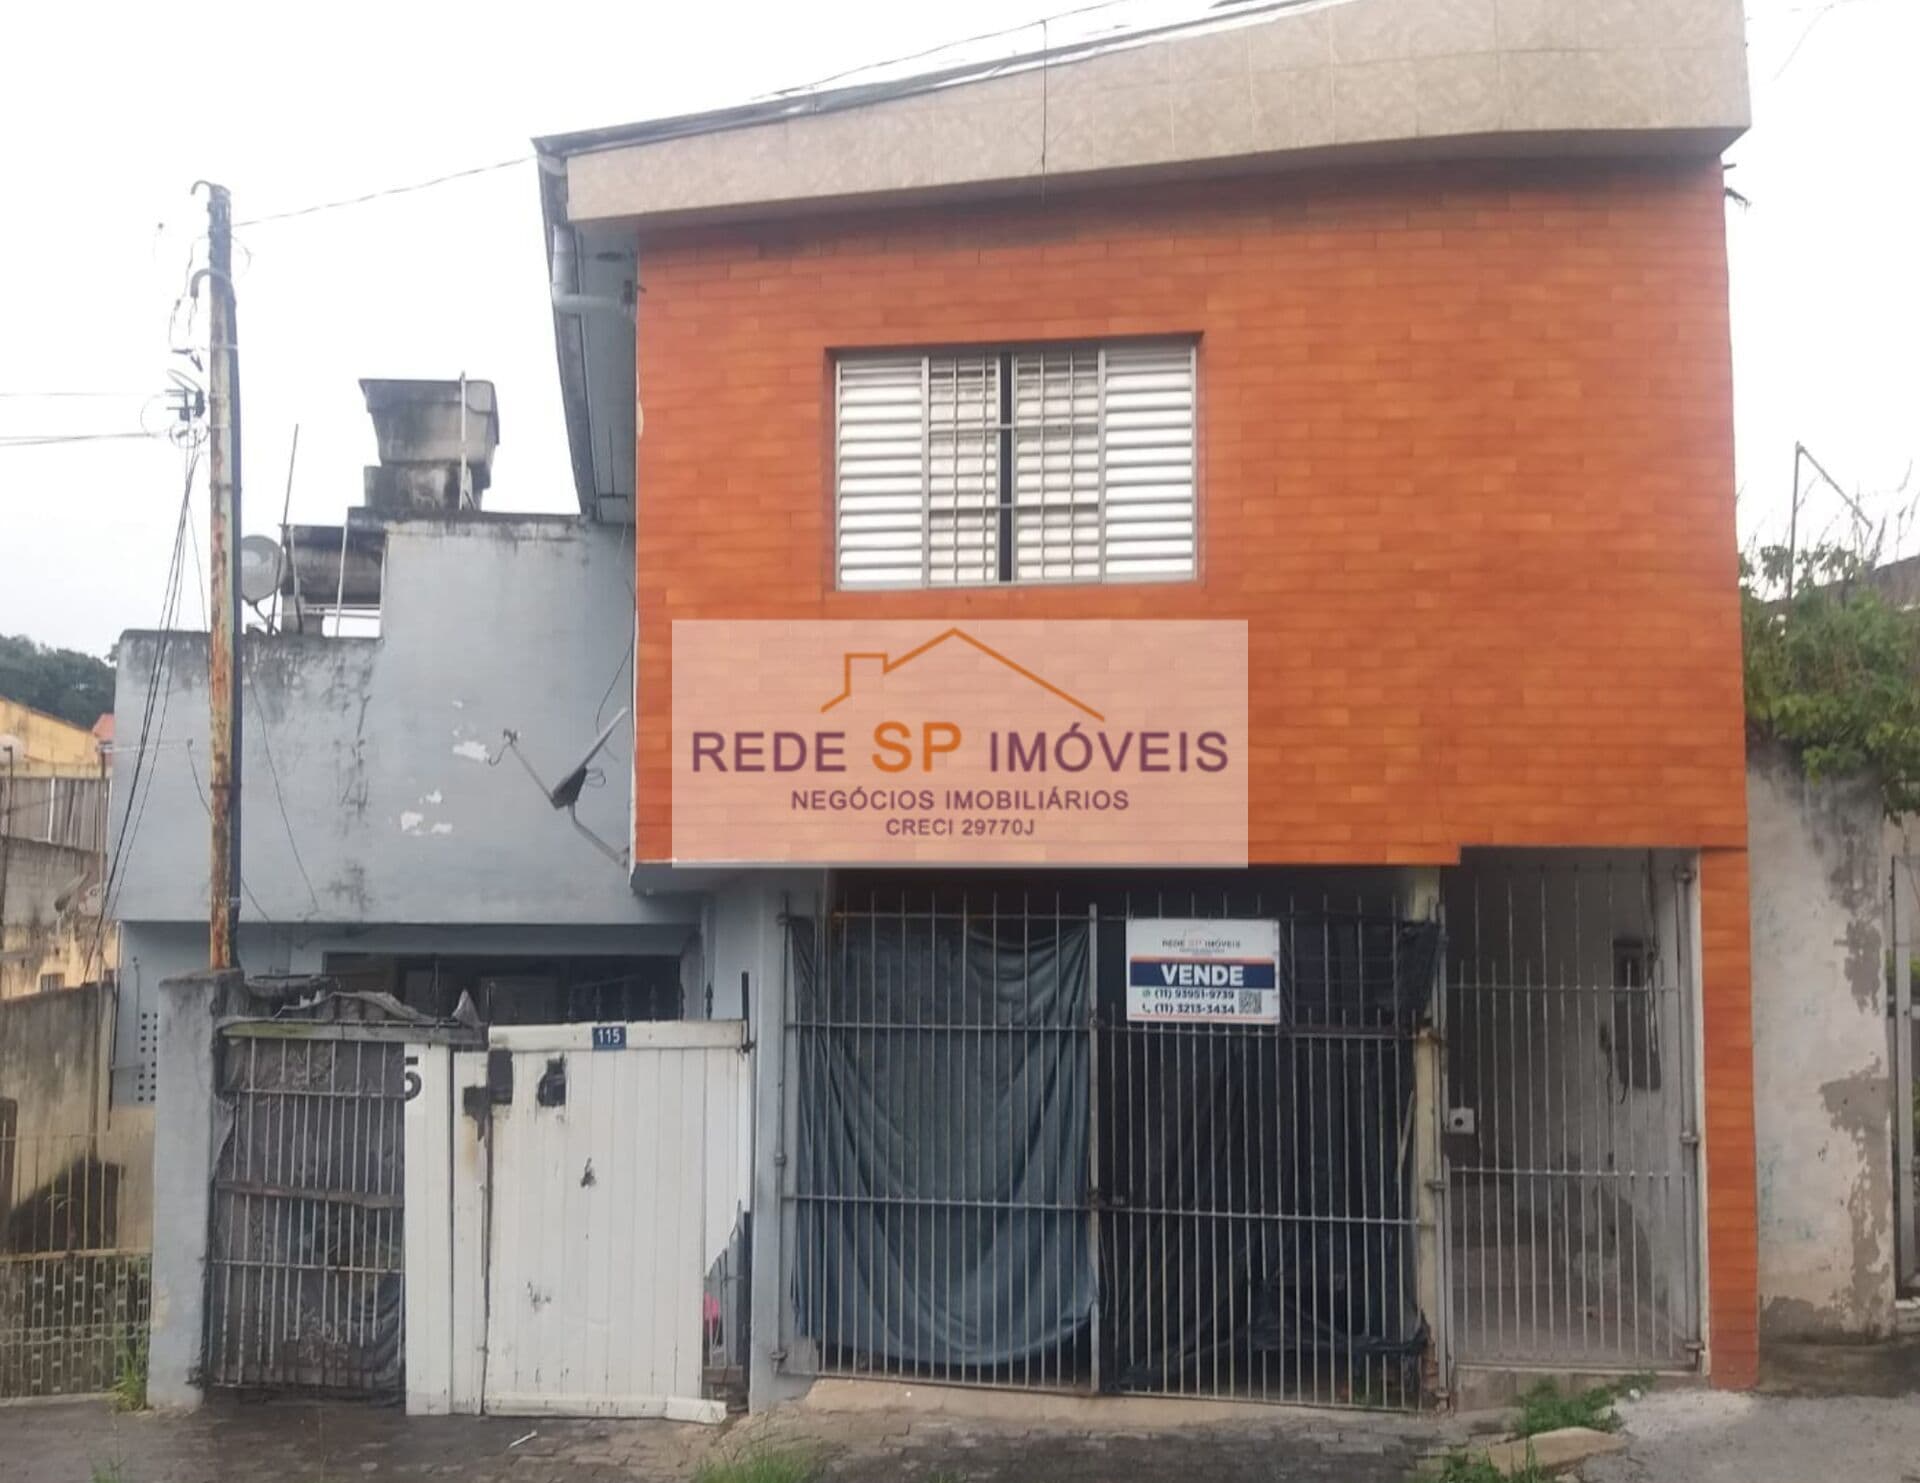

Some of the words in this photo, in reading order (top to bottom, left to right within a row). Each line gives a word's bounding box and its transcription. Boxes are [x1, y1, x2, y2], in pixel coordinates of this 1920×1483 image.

[1160, 964, 1244, 986] VENDE
[1154, 989, 1172, 999] (11)
[1154, 1003, 1174, 1014] (11)
[598, 1028, 620, 1044] 115
